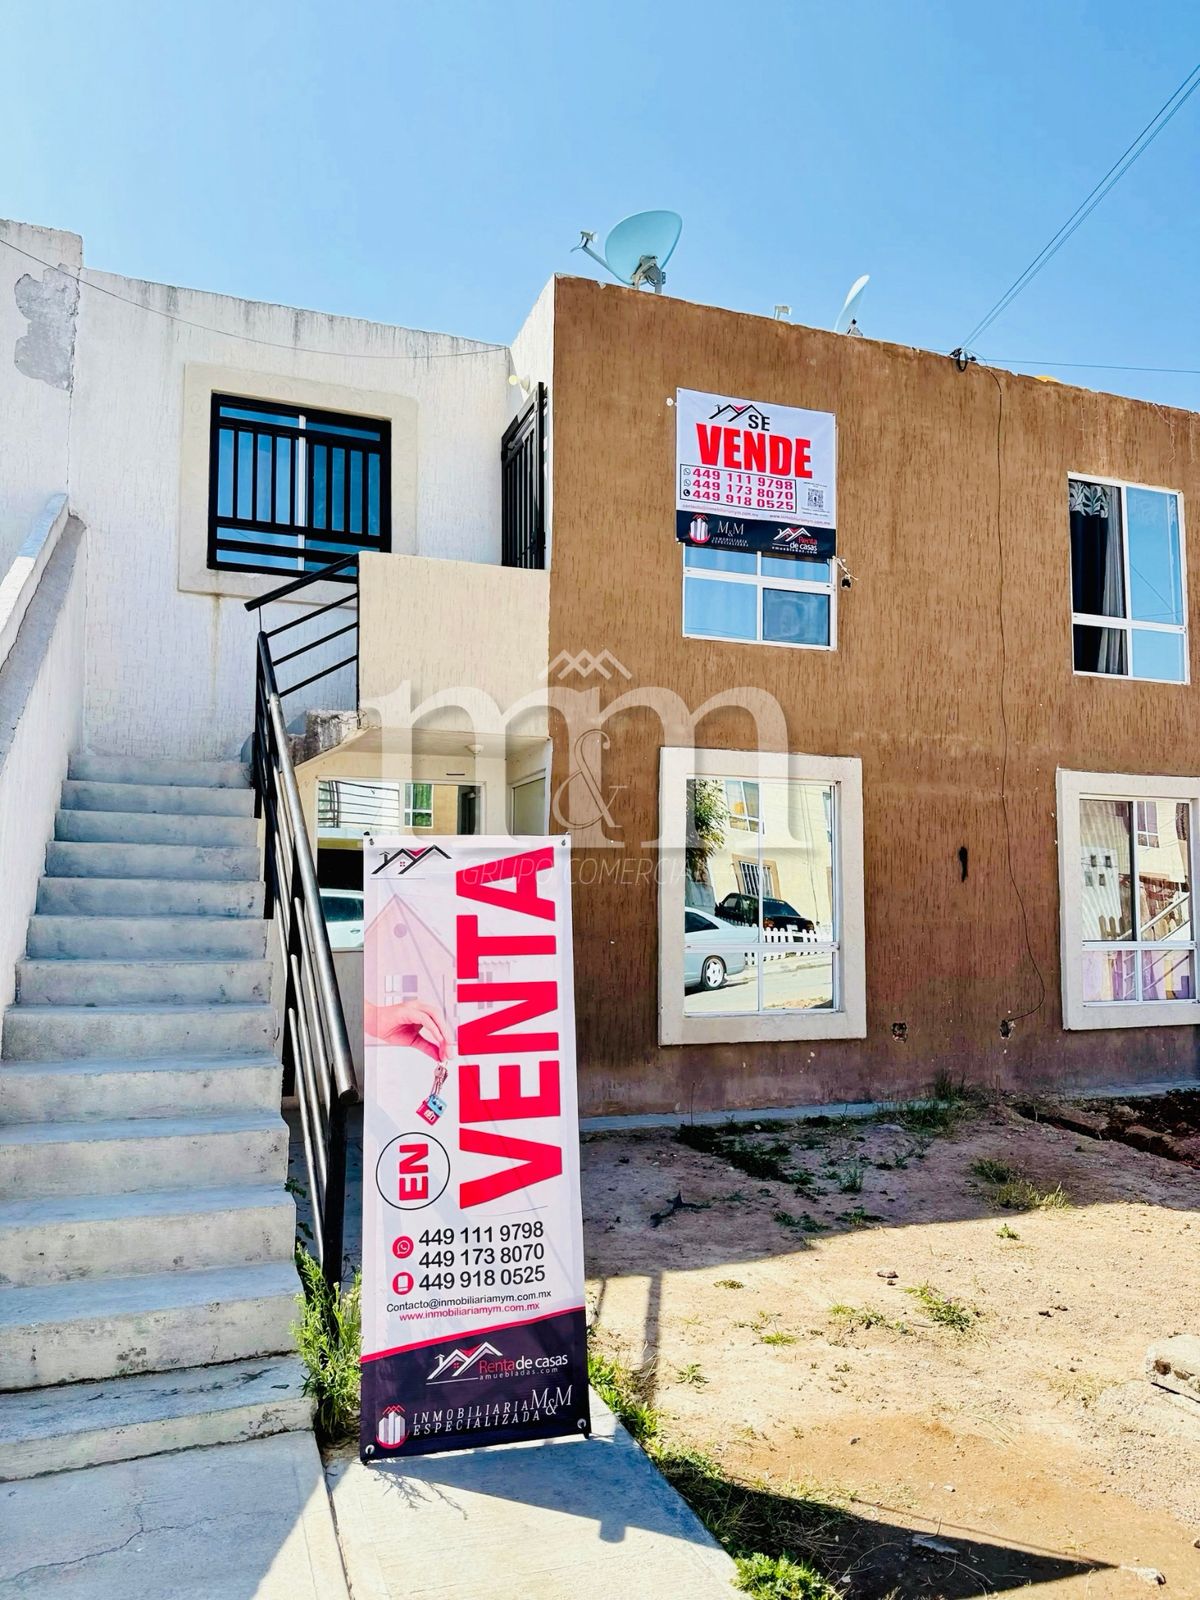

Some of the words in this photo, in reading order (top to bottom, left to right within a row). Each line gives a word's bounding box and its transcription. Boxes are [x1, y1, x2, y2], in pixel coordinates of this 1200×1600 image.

[748, 414, 770, 432] SE
[696, 423, 813, 479] VENDE
[692, 468, 720, 481] 449
[727, 472, 751, 485] 111
[757, 476, 794, 490] 9798
[692, 479, 720, 492] 449
[727, 483, 752, 496] 173
[757, 487, 794, 501] 8070
[692, 489, 720, 502] 449
[725, 493, 752, 506] 918
[757, 496, 794, 511] 0525
[717, 520, 745, 537] M&M
[790, 541, 799, 549] de
[800, 543, 818, 552] casas
[456, 846, 563, 1210] VENTA
[399, 1143, 429, 1201] EN
[419, 1229, 455, 1247] 449
[460, 1226, 493, 1244] 111
[499, 1220, 544, 1242] 9798
[419, 1250, 455, 1269] 449
[460, 1248, 495, 1266] 173
[500, 1243, 545, 1264] 8070
[419, 1272, 455, 1291] 449
[460, 1270, 495, 1288] 918
[500, 1265, 545, 1286] 0525
[386, 1290, 552, 1313] Contacto@inmobiliariamym.com.mx
[399, 1302, 540, 1321] www.inmobiliariamym.com.mx
[535, 1354, 568, 1367] casas
[479, 1367, 558, 1381] amuebladas.com
[413, 1400, 529, 1425] INMOBILIARIA
[530, 1385, 573, 1416] M&M
[413, 1410, 540, 1436] ESPECIALIZADA
